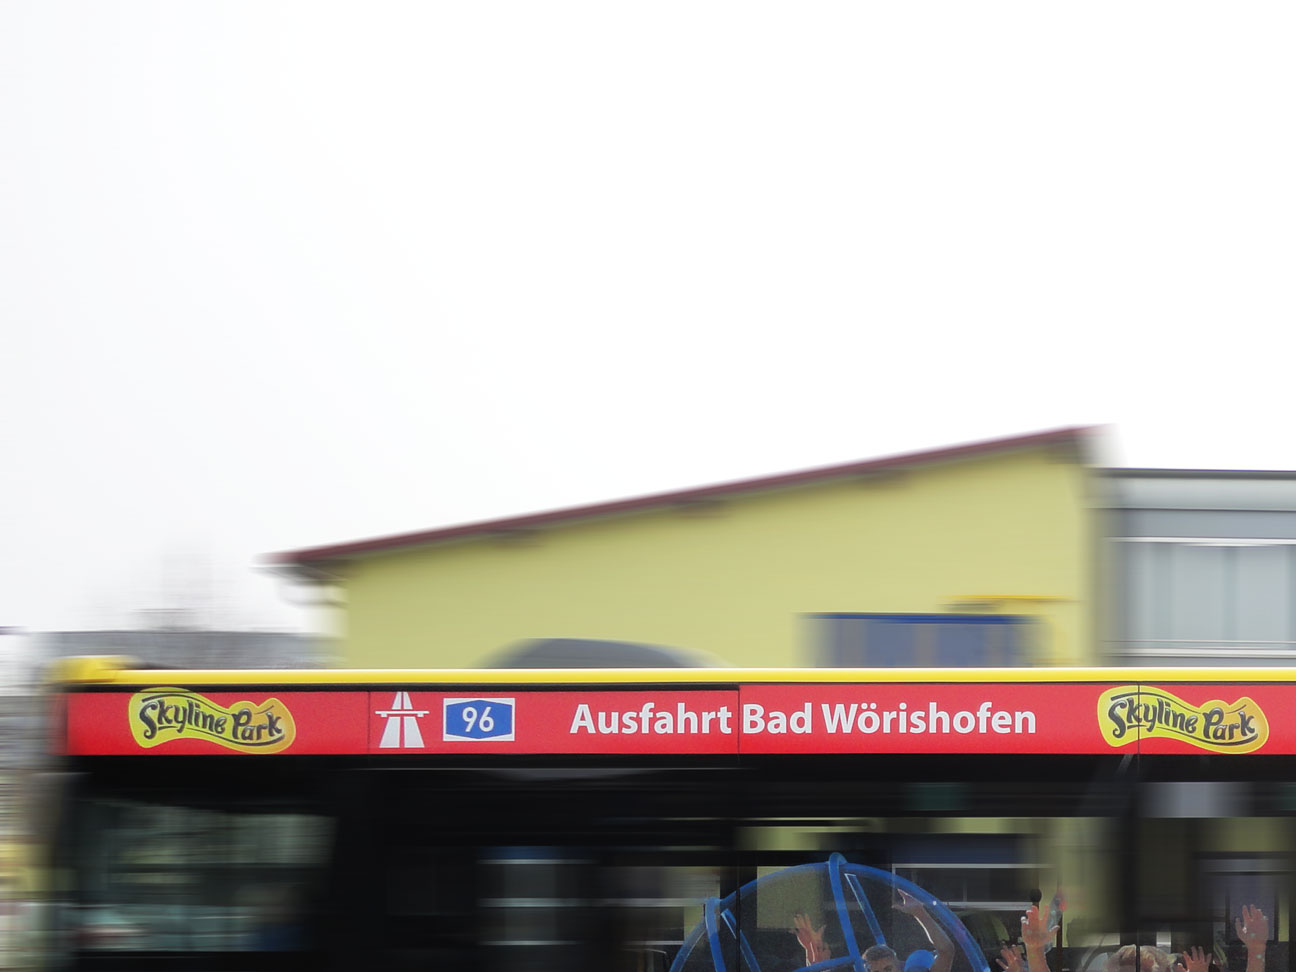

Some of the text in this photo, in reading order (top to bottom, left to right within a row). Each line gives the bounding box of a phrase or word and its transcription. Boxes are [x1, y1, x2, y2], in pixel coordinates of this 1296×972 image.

[139, 699, 283, 741] Skyline Park
[461, 706, 495, 733] 96
[569, 702, 1037, 735] Ausfahrt Bad Wörishofen
[1108, 697, 1256, 741] Skyline Park
